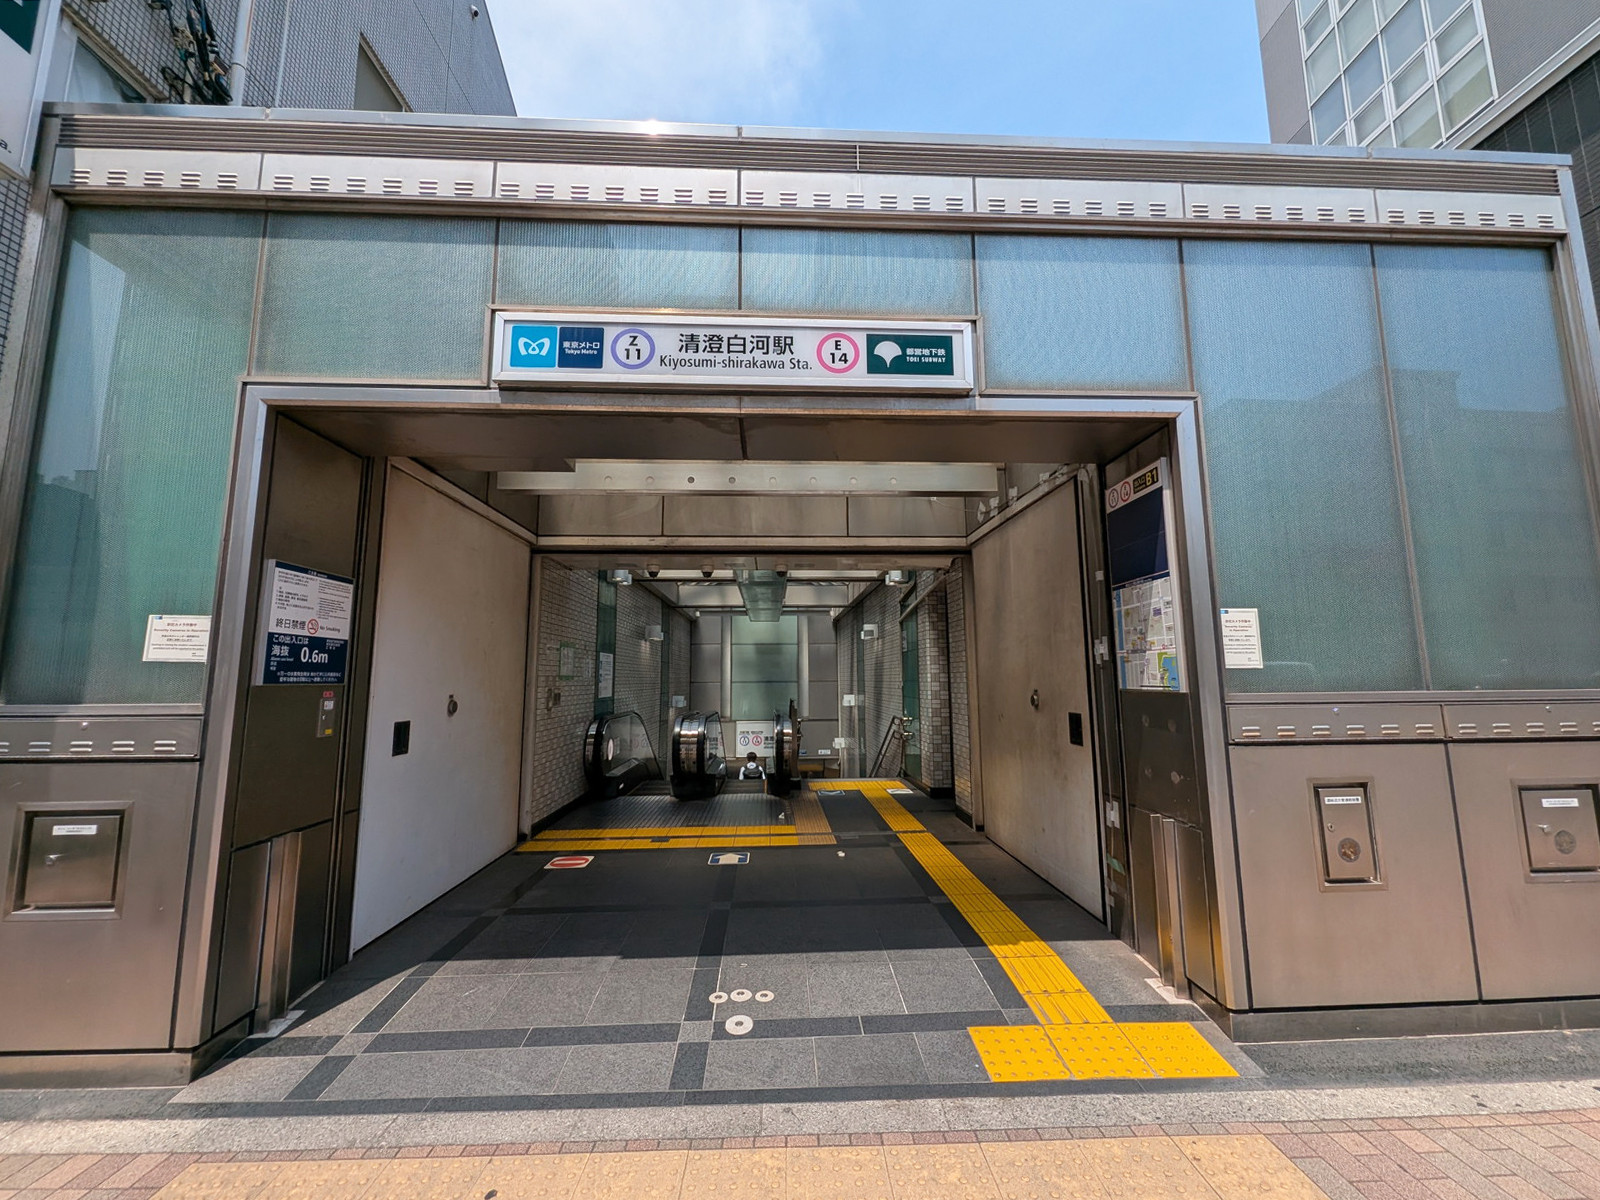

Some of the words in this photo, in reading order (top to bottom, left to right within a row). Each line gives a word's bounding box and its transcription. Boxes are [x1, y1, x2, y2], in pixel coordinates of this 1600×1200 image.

[562, 341, 600, 350] 東京メトロ
[629, 335, 638, 346] Z
[678, 333, 795, 355] 清澄白河駅
[835, 340, 842, 350] E
[625, 348, 641, 360] 11
[830, 352, 848, 364] 14
[659, 354, 785, 370] Kiyosumi-shirakawa
[789, 357, 813, 370] Sta.
[1146, 469, 1158, 486] B1
[275, 617, 307, 631] 終日禁煙
[326, 625, 341, 633] Smoking
[272, 634, 309, 645] この出入口は
[271, 644, 290, 656] 海抜
[300, 646, 329, 663] 0.6m
